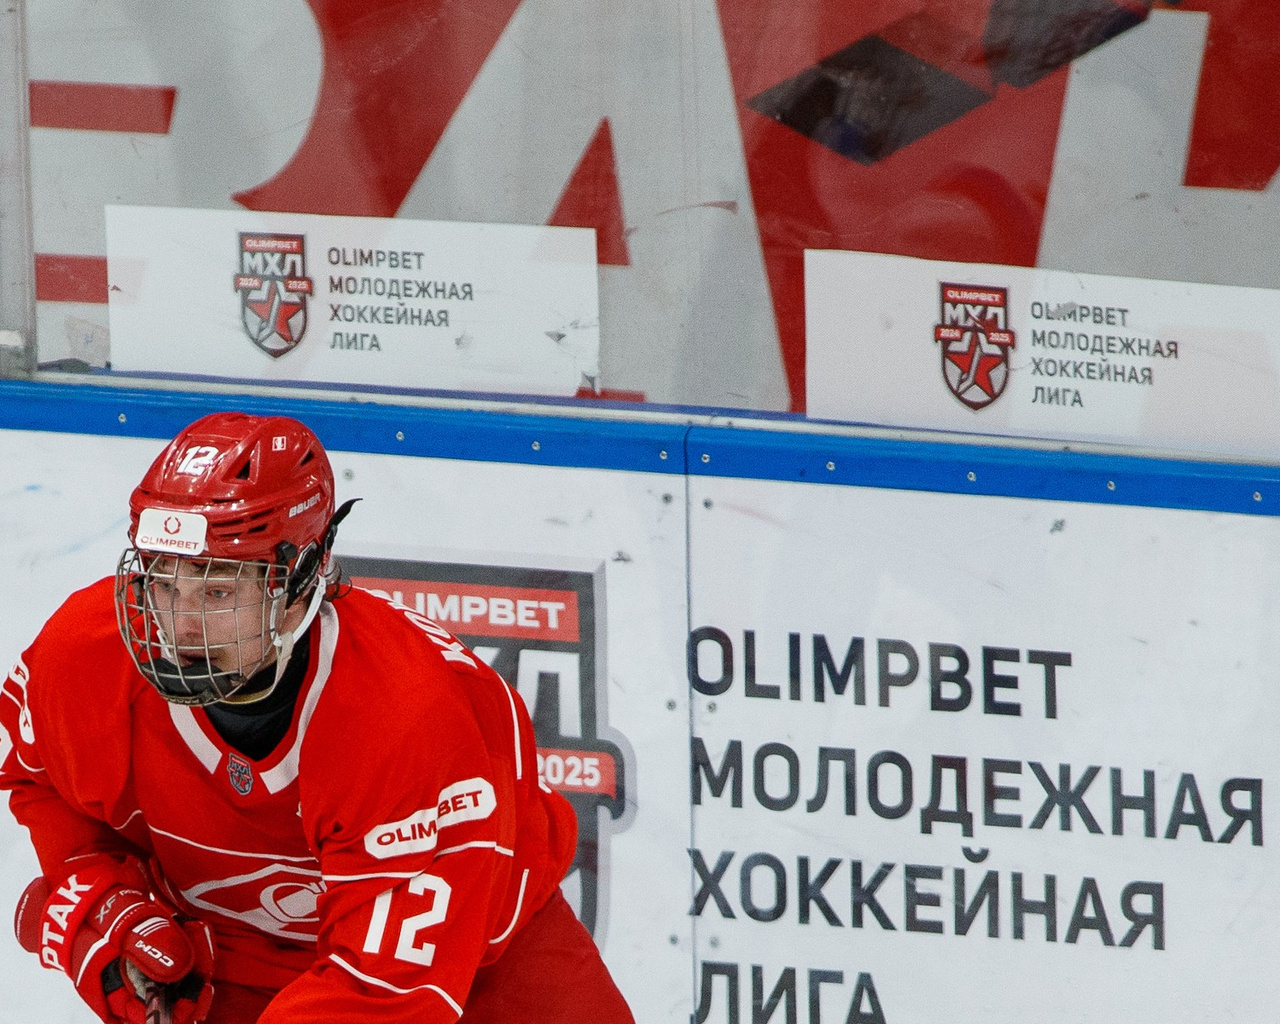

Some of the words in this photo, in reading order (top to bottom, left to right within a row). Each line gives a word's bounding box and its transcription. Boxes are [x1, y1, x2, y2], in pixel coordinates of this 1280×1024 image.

[246, 239, 298, 249] OLIMPBET
[243, 252, 303, 276] МХЛ
[328, 247, 424, 270] OLIMPBET
[329, 275, 473, 301] МОЛОДЕЖНАЯ
[947, 290, 1001, 302] OLIMPBET
[329, 302, 449, 327] ХОККЕЙНАЯ
[944, 303, 1005, 329] МХЛ
[1031, 301, 1128, 327] OLMPBET
[330, 332, 381, 351] ЛИГА
[1031, 329, 1178, 359] МОЛОДЕЖНАЯ
[1031, 357, 1153, 385] ХОККЕЙНАЯ
[1031, 386, 1083, 408] ЛИГА
[177, 445, 219, 476] 12
[288, 493, 322, 518] BAUER
[140, 535, 200, 551] OLIMPBET
[686, 625, 1073, 719] OLIMPBET
[690, 736, 1265, 848] МОЛОДЕЖНАЯ
[376, 790, 483, 846] OLIMBET
[687, 846, 1166, 951] ХОККЕЙНАЯ
[41, 874, 95, 972] РТАК
[363, 873, 452, 967] 12
[134, 939, 175, 968] CCM
